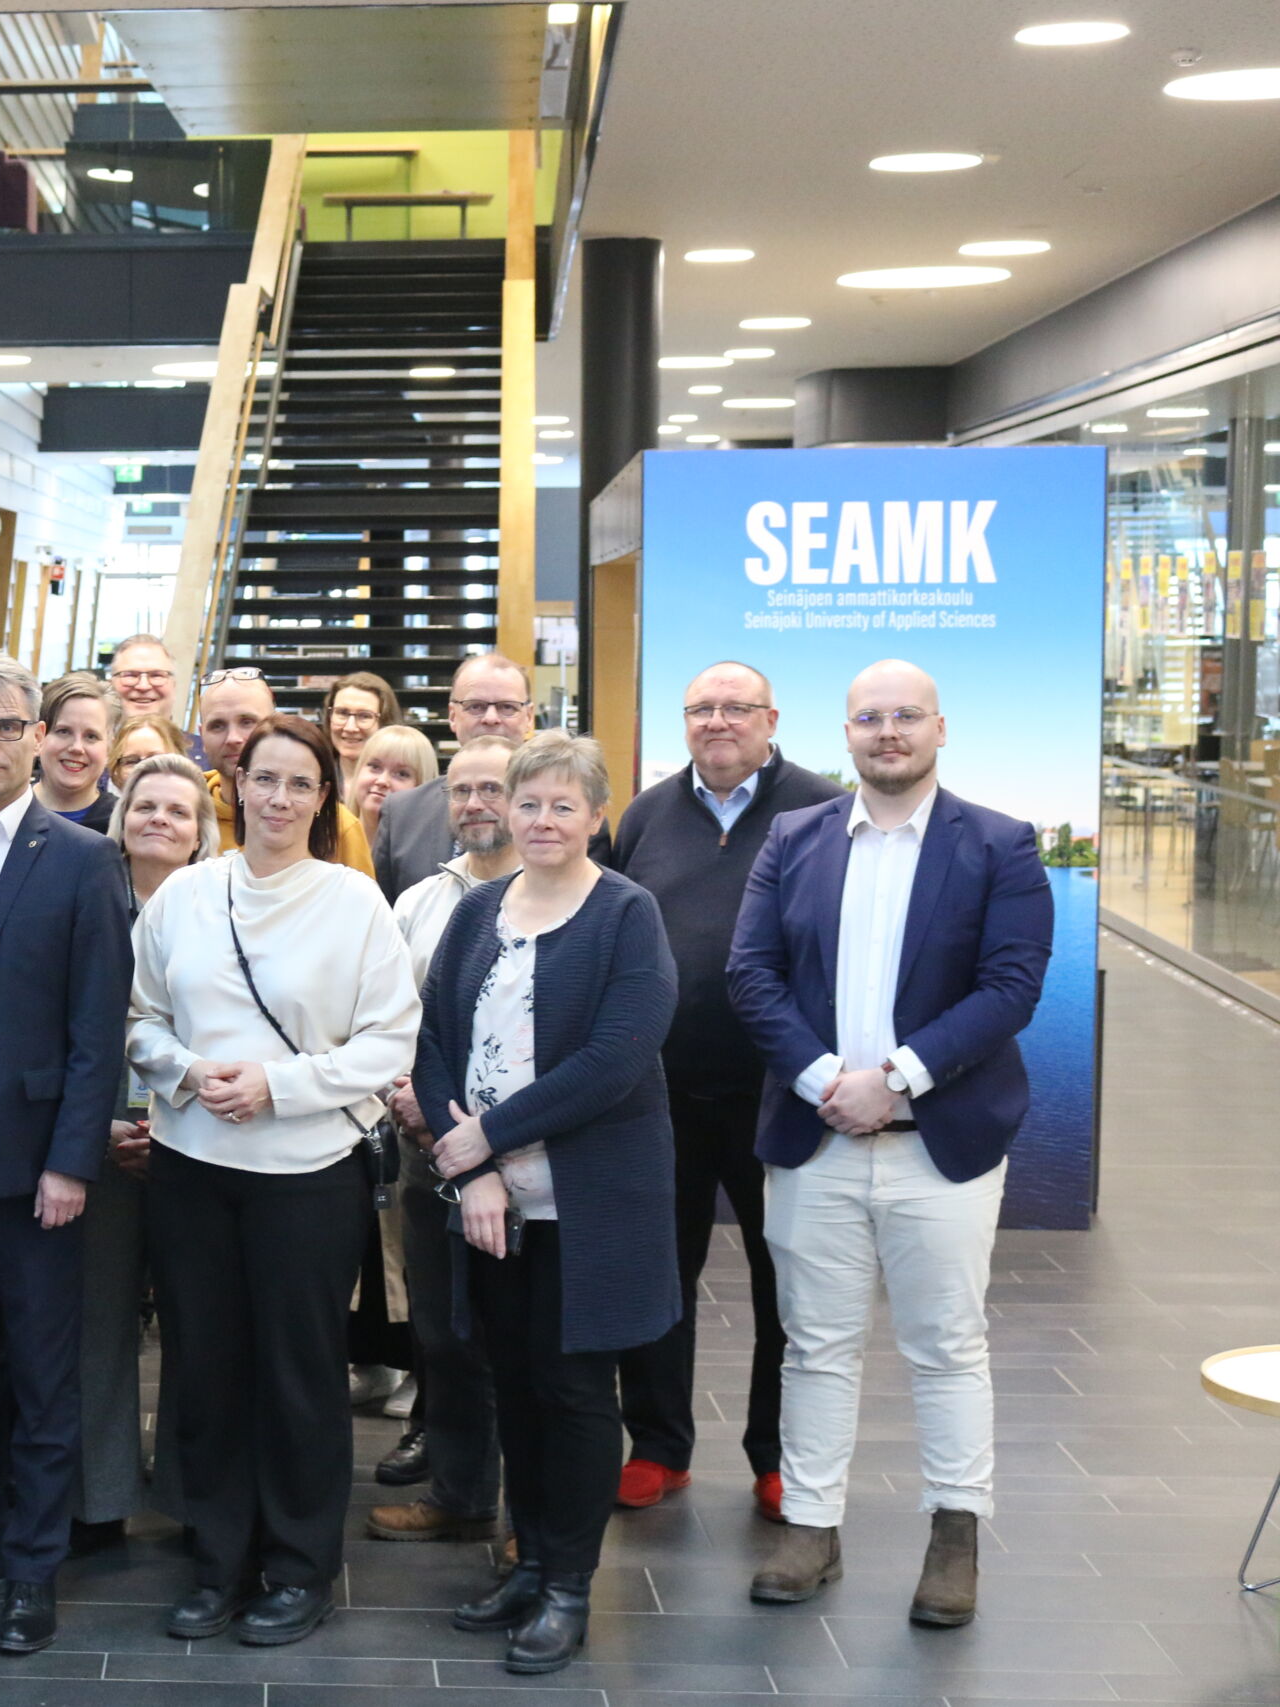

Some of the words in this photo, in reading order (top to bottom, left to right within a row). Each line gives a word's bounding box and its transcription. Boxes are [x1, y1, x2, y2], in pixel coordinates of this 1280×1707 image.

[744, 500, 998, 586] SEAMK
[767, 588, 833, 610] Seinäjoen
[836, 588, 974, 607] ammattikorkeakoulu
[744, 610, 802, 632] Seinäjoki
[806, 610, 869, 632] University
[872, 610, 887, 628] of
[888, 610, 937, 631] Applied
[939, 610, 997, 629] Sciences
